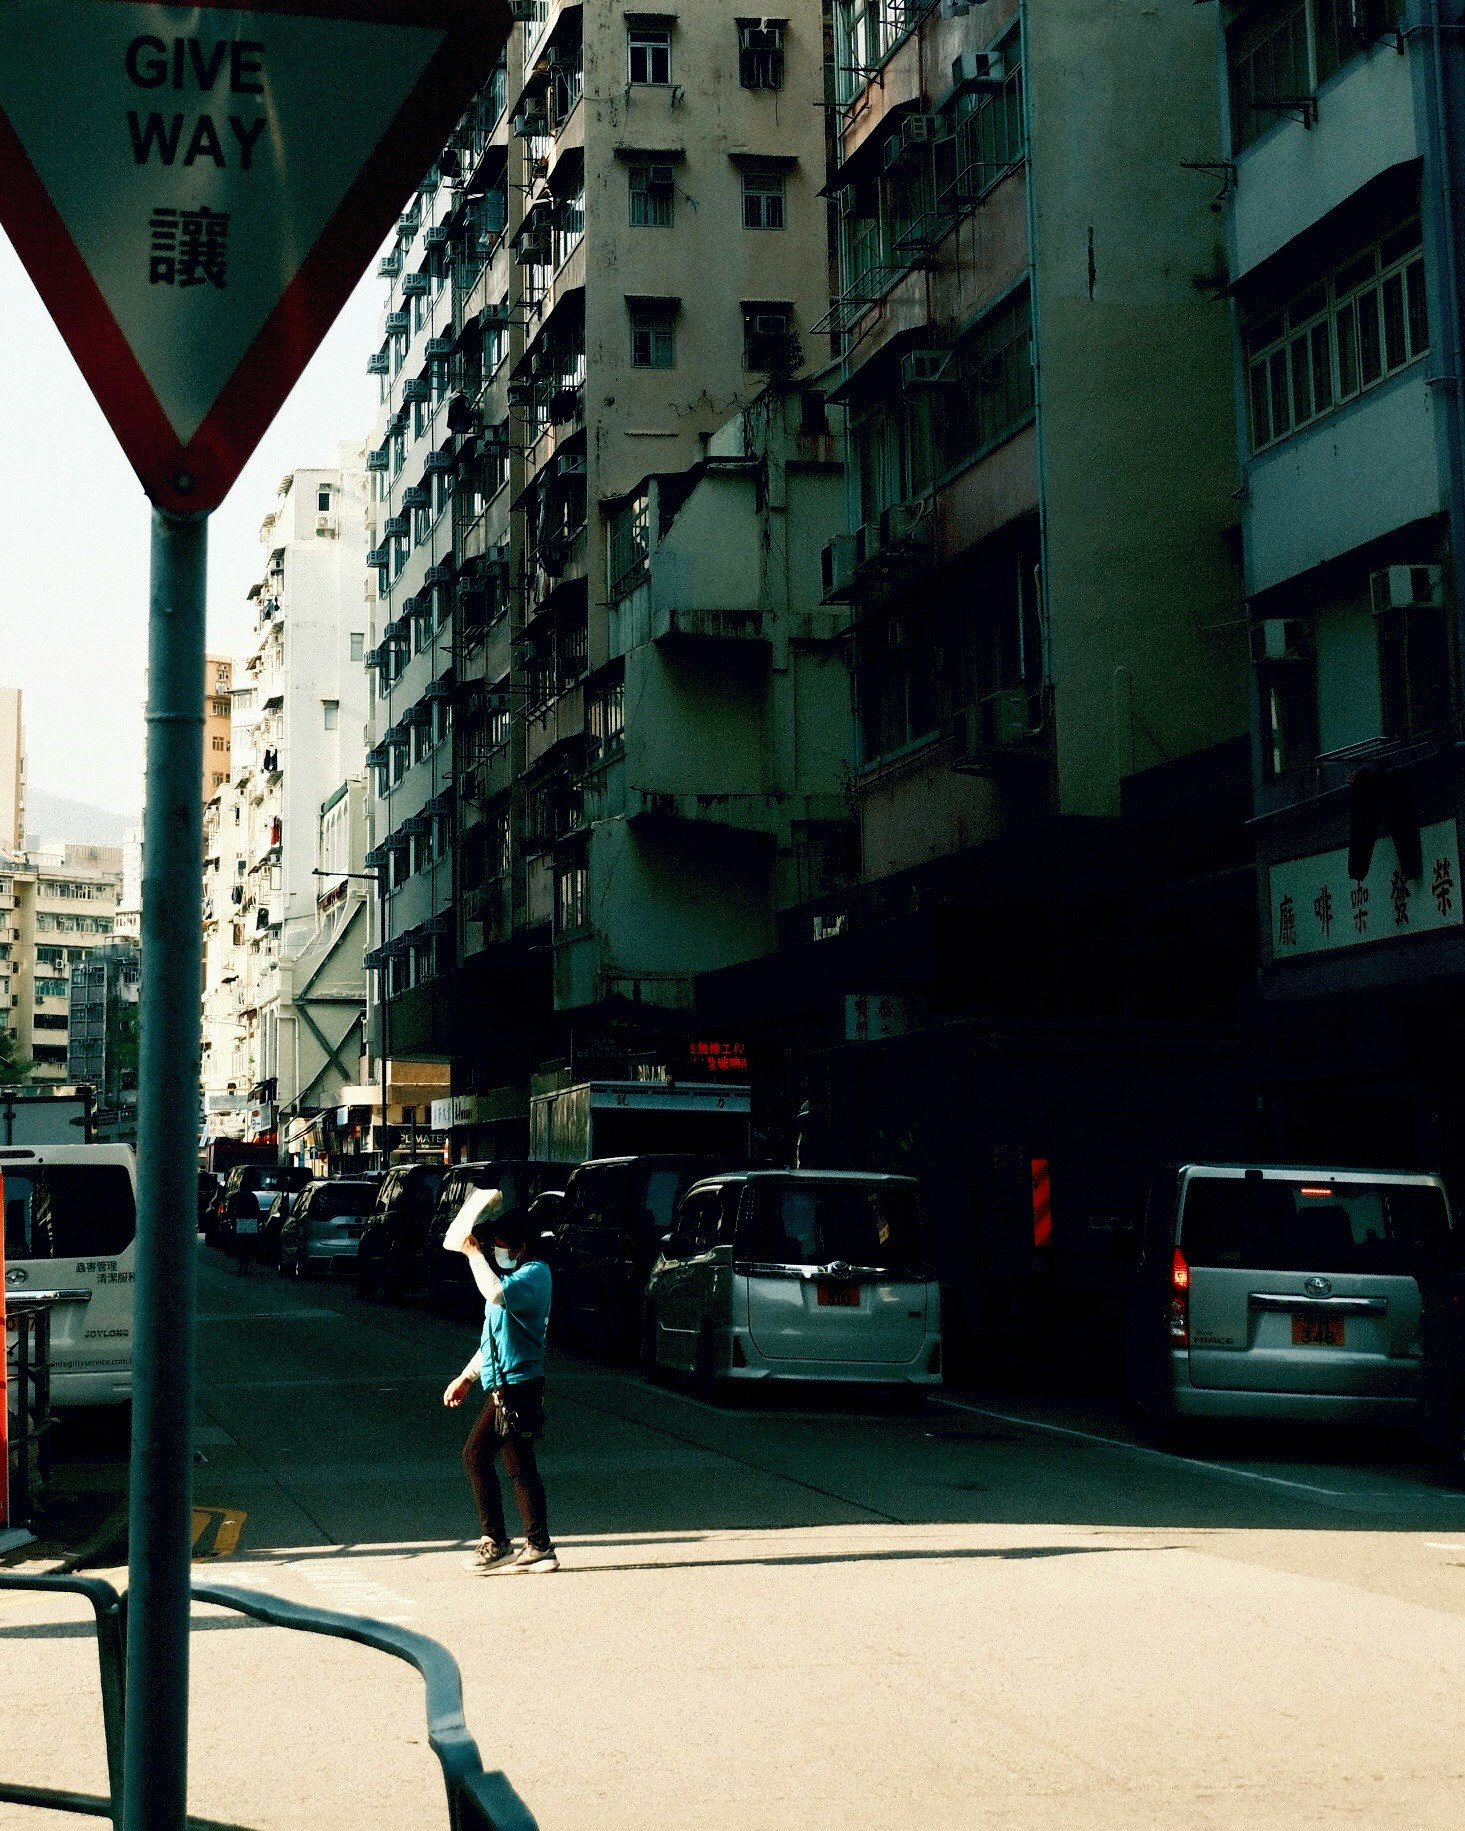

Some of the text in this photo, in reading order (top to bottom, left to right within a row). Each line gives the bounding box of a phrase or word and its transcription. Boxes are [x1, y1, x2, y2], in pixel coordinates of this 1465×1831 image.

[125, 35, 266, 94] GIVE
[126, 110, 268, 170] WAY
[149, 206, 230, 289] 讓
[76, 1261, 118, 1273] 蟲害管理
[84, 1329, 130, 1338] JOYLONG
[1193, 1337, 1235, 1345] HIACE
